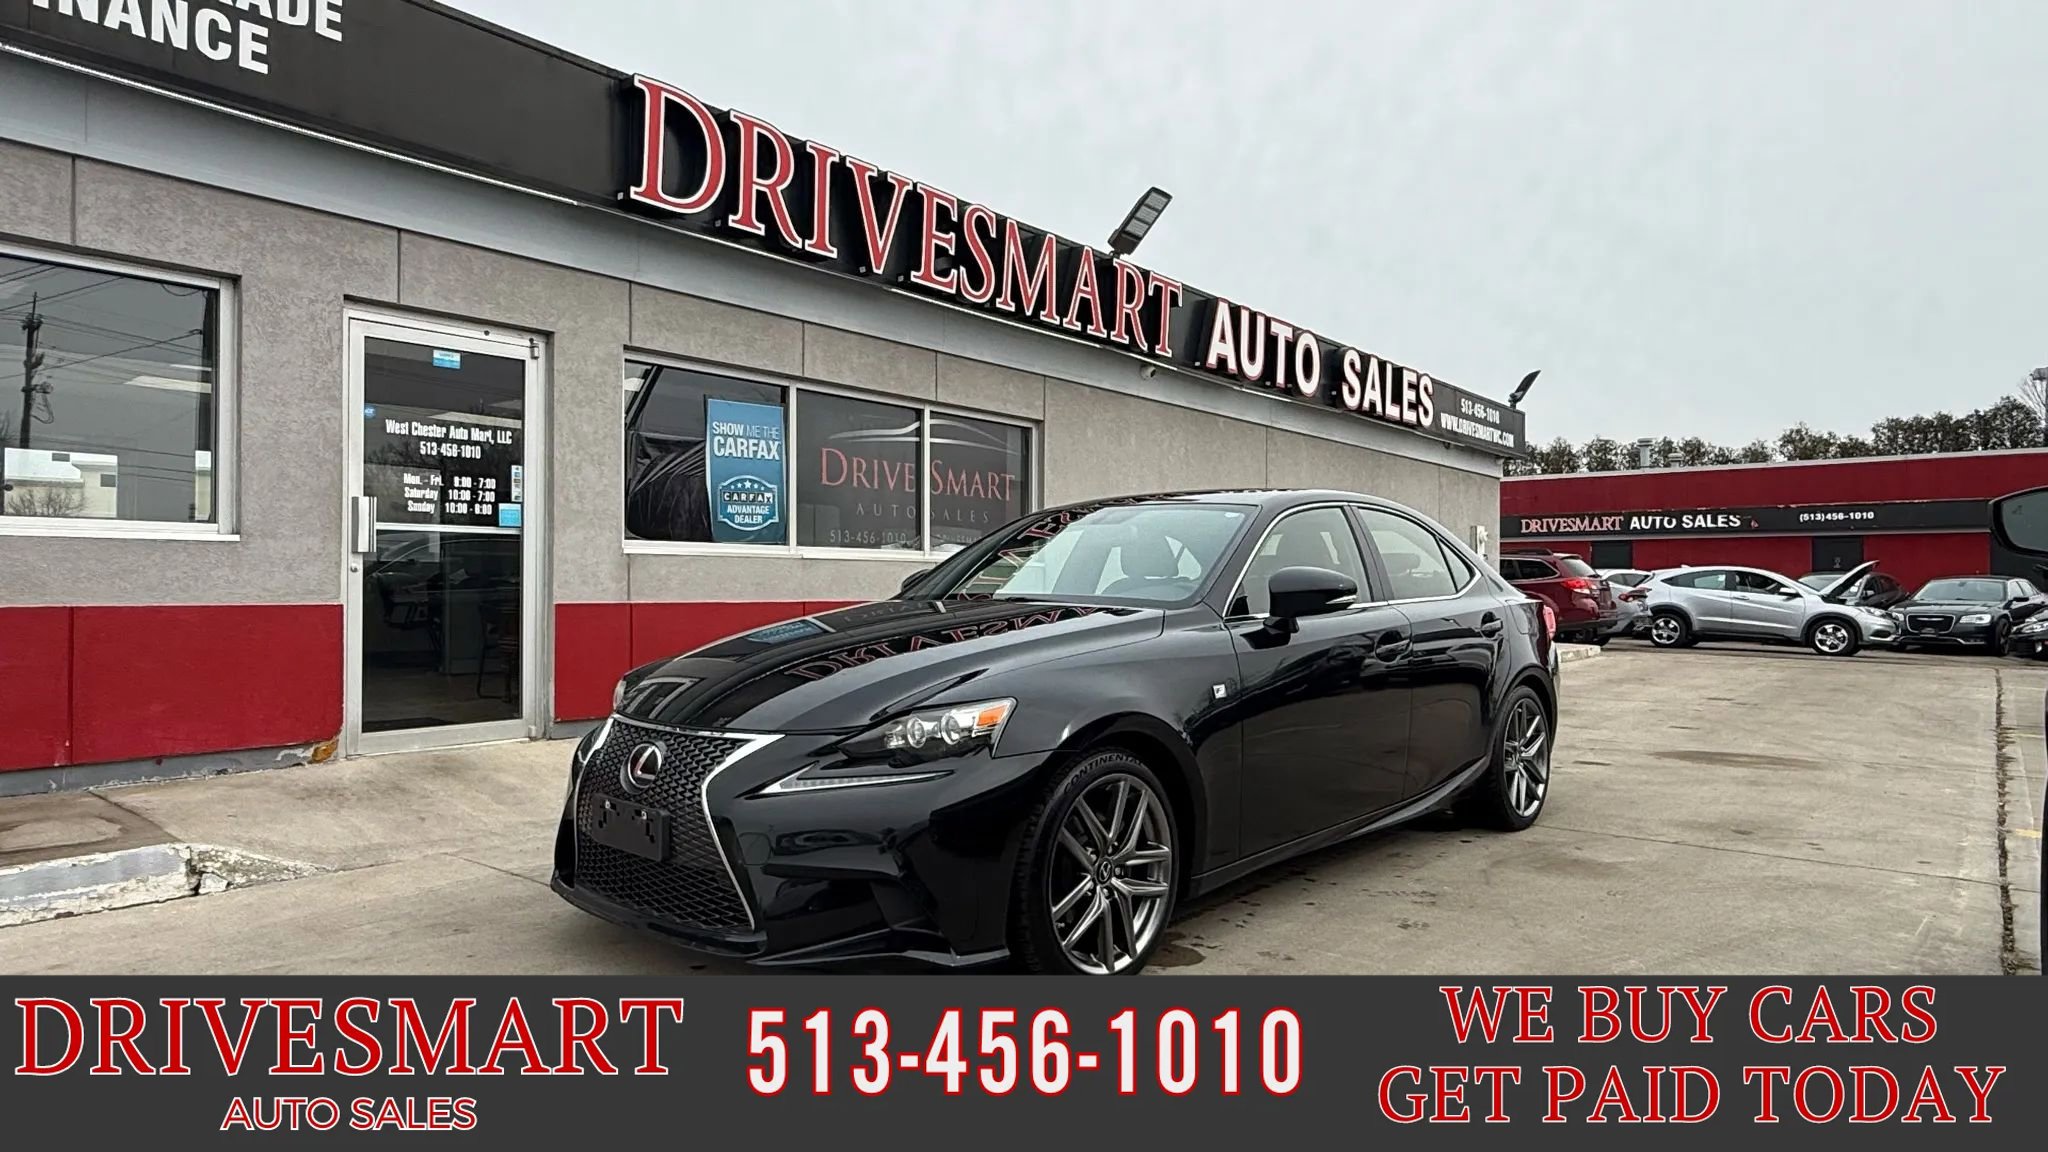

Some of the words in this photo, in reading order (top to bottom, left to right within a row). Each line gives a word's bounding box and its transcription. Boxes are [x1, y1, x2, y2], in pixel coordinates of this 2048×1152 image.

[630, 73, 1182, 358] DRIVESMART
[1205, 298, 1321, 399] AUTO
[1341, 346, 1435, 429] SALES
[1461, 398, 1500, 425] 513-456-1010
[385, 419, 409, 435] West
[411, 421, 447, 438] Chester
[448, 425, 469, 440] Auto
[470, 427, 495, 445] Mart,
[496, 430, 513, 445] LLC
[712, 421, 744, 436] SHOW
[746, 424, 761, 438] ME
[763, 425, 780, 440] THE
[419, 441, 481, 459] 513-456-1010
[713, 436, 781, 461] CARFAX
[478, 477, 496, 489] 7:00
[404, 486, 439, 500] Saturday
[448, 489, 471, 501] 10:00
[477, 490, 496, 502] 7:00
[722, 491, 773, 504] CARFAX
[407, 500, 436, 514] Sunday
[445, 502, 468, 514] 10:00
[726, 504, 770, 515] ADVANTAGE
[856, 503, 917, 519] AUTO
[734, 514, 763, 524] DEALER
[1520, 515, 1624, 534] DRIVESMART
[1629, 515, 1677, 530] AUTO
[1681, 514, 1741, 529] SALES
